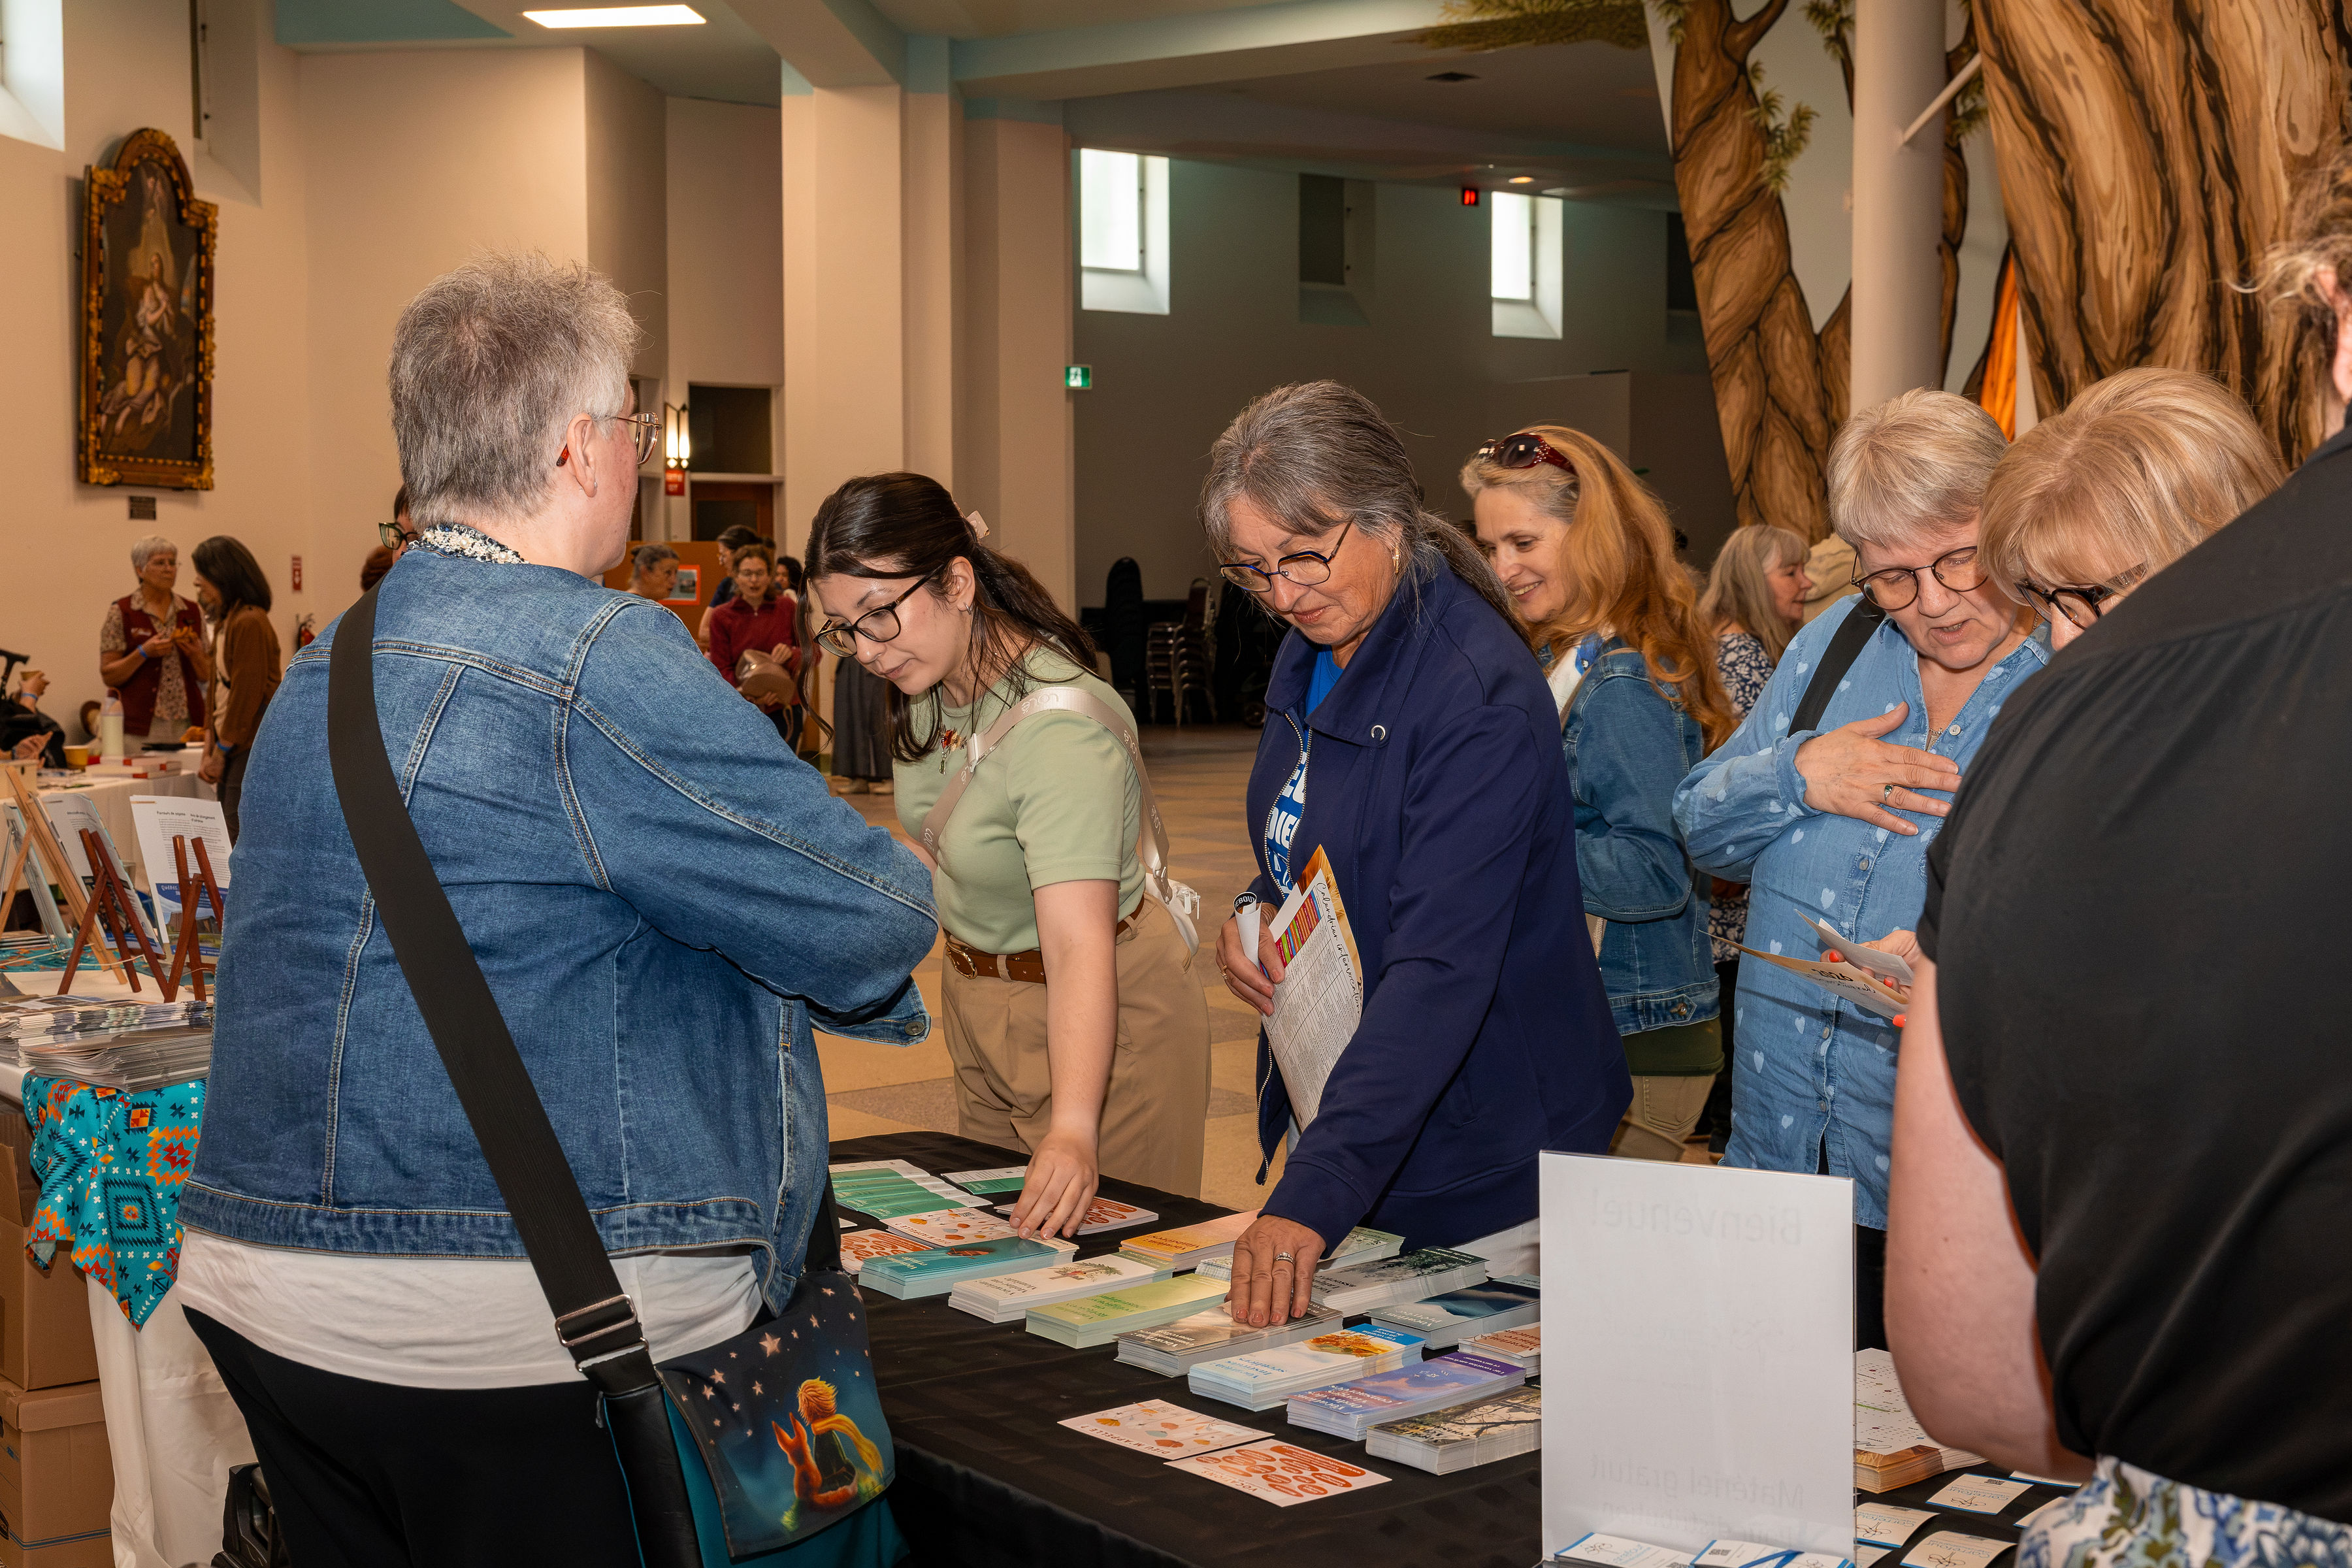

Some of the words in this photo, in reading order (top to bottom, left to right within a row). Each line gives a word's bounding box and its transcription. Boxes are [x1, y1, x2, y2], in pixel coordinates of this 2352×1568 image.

[1316, 883, 1339, 941] Calendrier
[1088, 1428, 1145, 1448] M'APPELLE
[1144, 1445, 1170, 1455] DIEU
[1201, 1471, 1258, 1492] VOCATIONS
[1945, 1486, 2009, 1501] Carrefour
[1857, 1514, 1914, 1527] Carrefou
[1923, 1541, 1991, 1558] Carrefour
